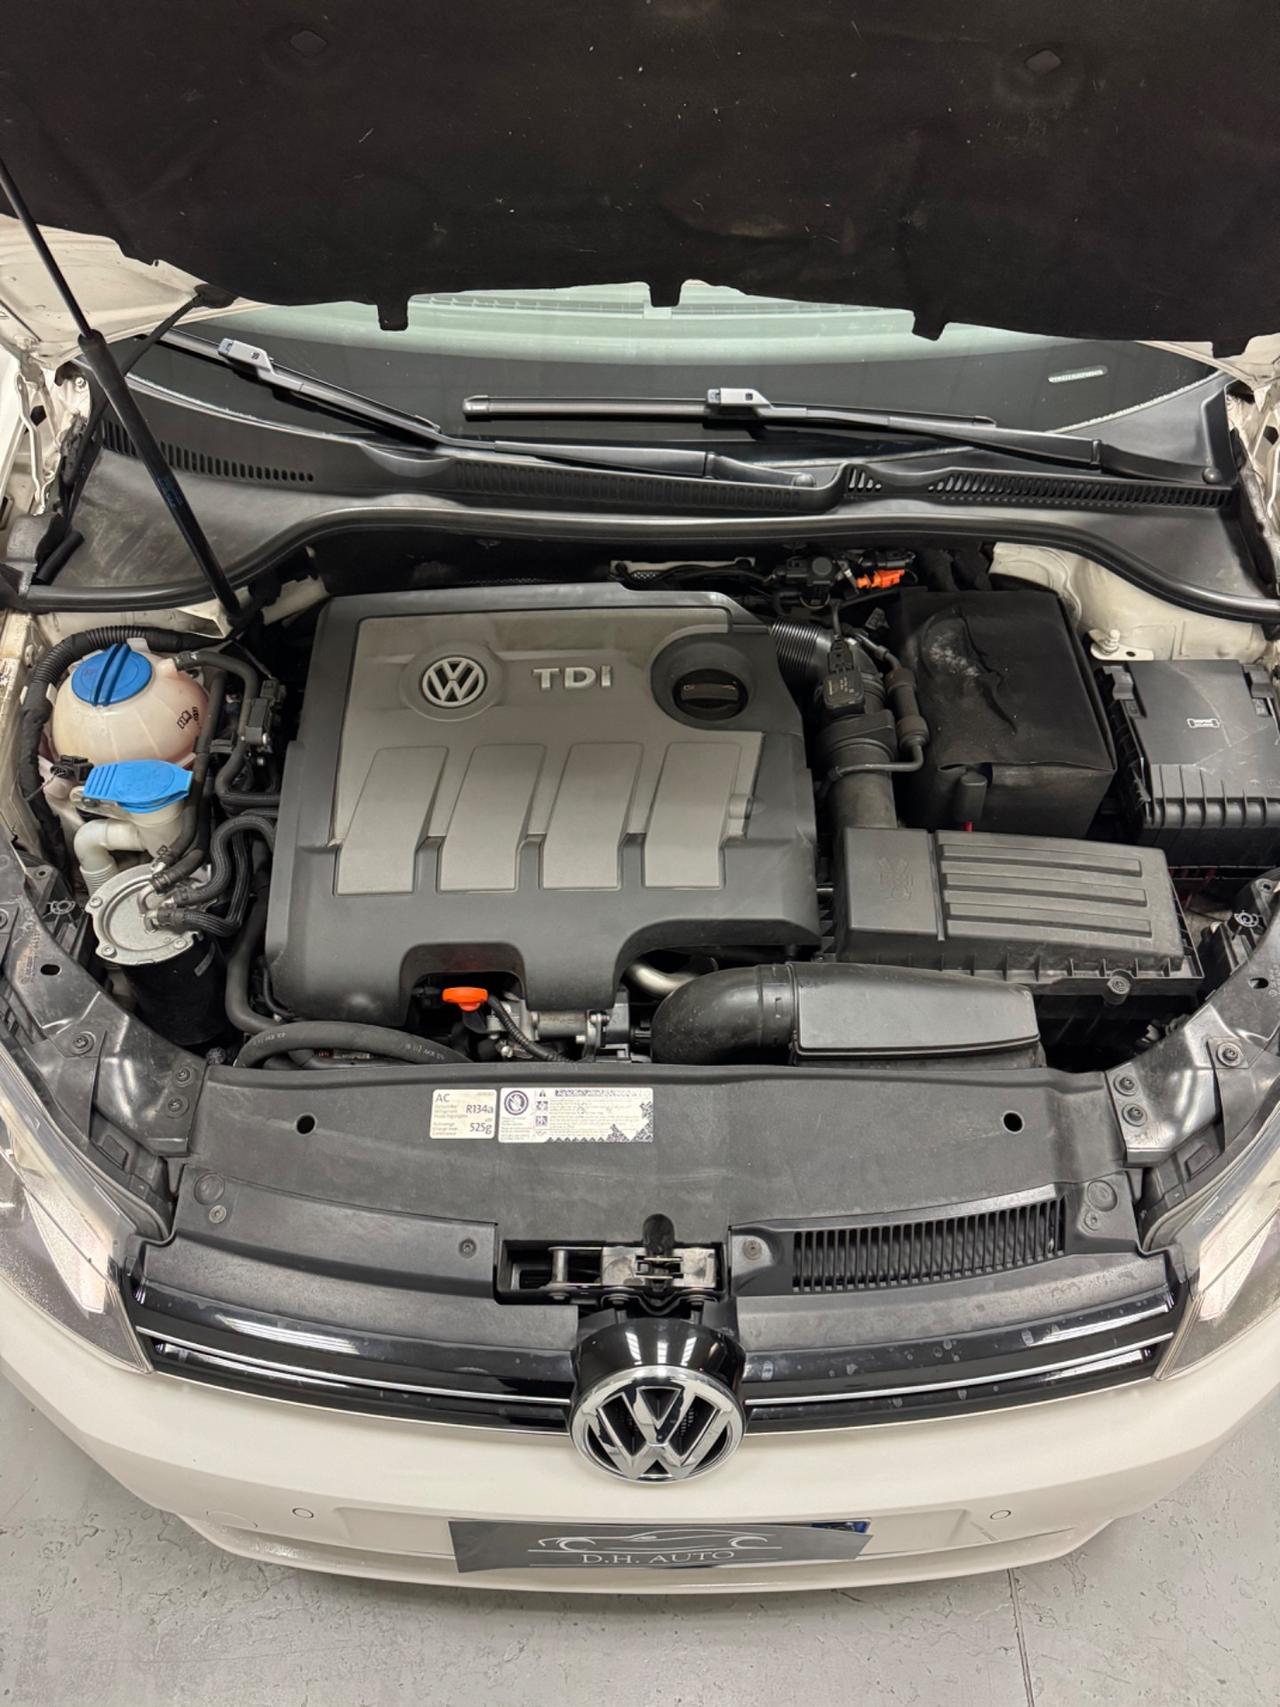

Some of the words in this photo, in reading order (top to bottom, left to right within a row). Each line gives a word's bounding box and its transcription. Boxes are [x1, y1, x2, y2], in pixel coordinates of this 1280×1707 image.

[533, 665, 612, 689] TDI
[435, 1093, 450, 1103] AC
[465, 1104, 494, 1114] R134a
[470, 1122, 493, 1135] 525g
[582, 1553, 640, 1564] D.H.
[648, 1551, 735, 1563] AUTO
